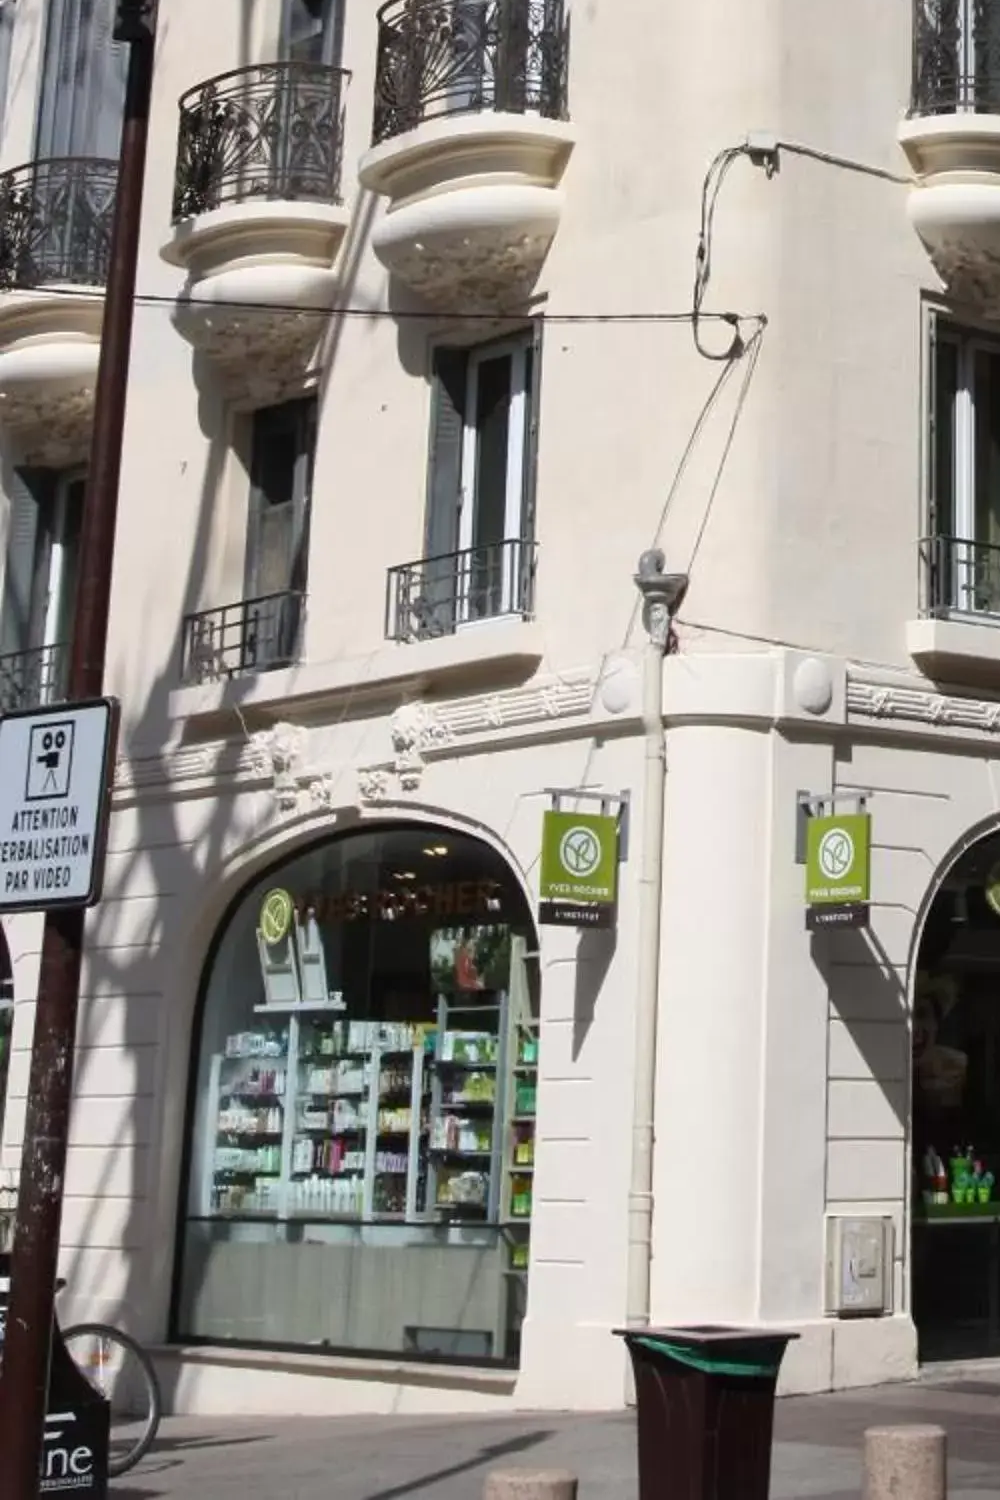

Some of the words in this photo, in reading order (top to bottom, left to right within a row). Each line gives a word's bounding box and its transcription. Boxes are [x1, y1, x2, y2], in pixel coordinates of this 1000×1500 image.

[11, 805, 79, 832] ATTENTION
[0, 832, 90, 863] ERBALISATION
[5, 869, 29, 893] PAR
[33, 865, 71, 891] VIDEO
